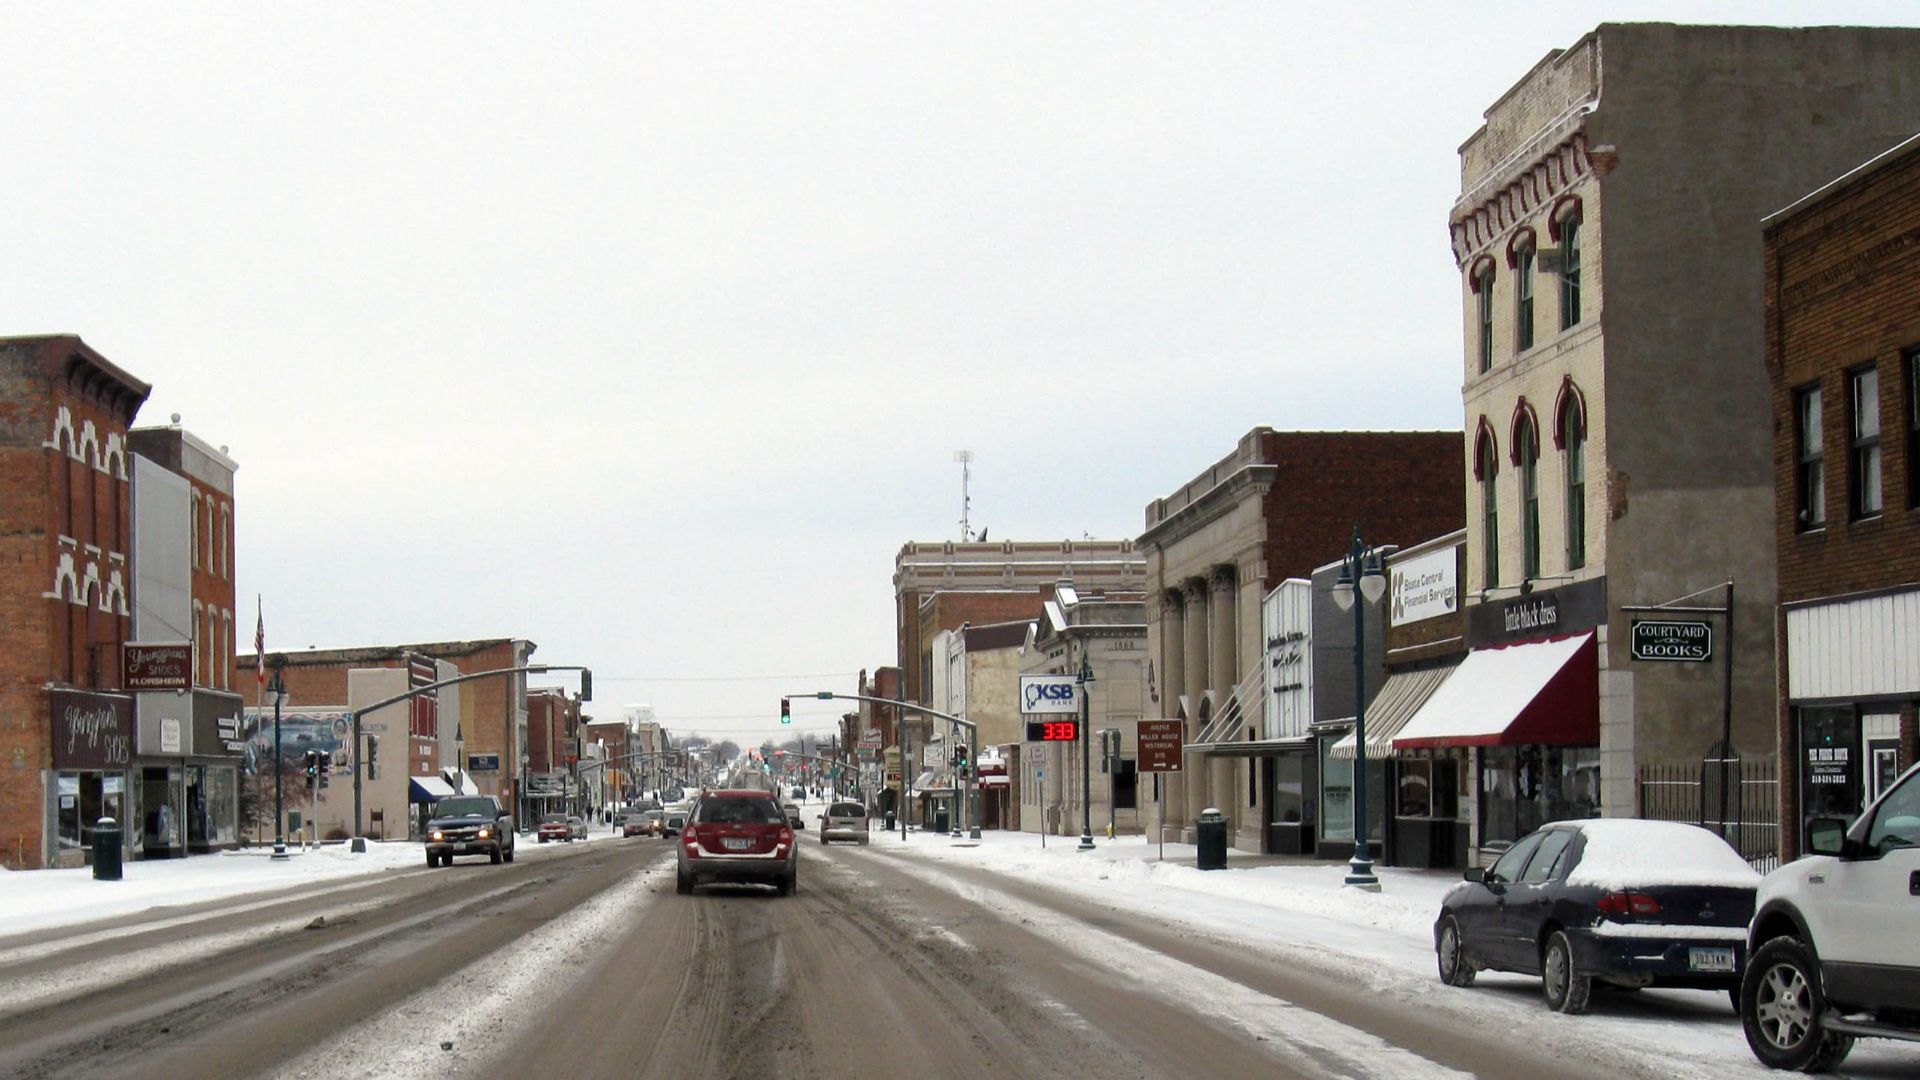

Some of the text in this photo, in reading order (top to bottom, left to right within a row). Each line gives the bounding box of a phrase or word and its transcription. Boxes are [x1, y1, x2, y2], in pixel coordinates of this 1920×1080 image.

[1405, 568, 1444, 592] State Central
[1404, 585, 1456, 608] Financial Services
[1504, 600, 1557, 631] little black dress
[1639, 625, 1705, 638] COURTYARD
[1642, 644, 1704, 657] BOOKS
[148, 664, 181, 676] SHOES
[129, 677, 186, 686] FLORSHEIM
[1035, 683, 1074, 700] KSB
[1043, 721, 1075, 740] 3:33
